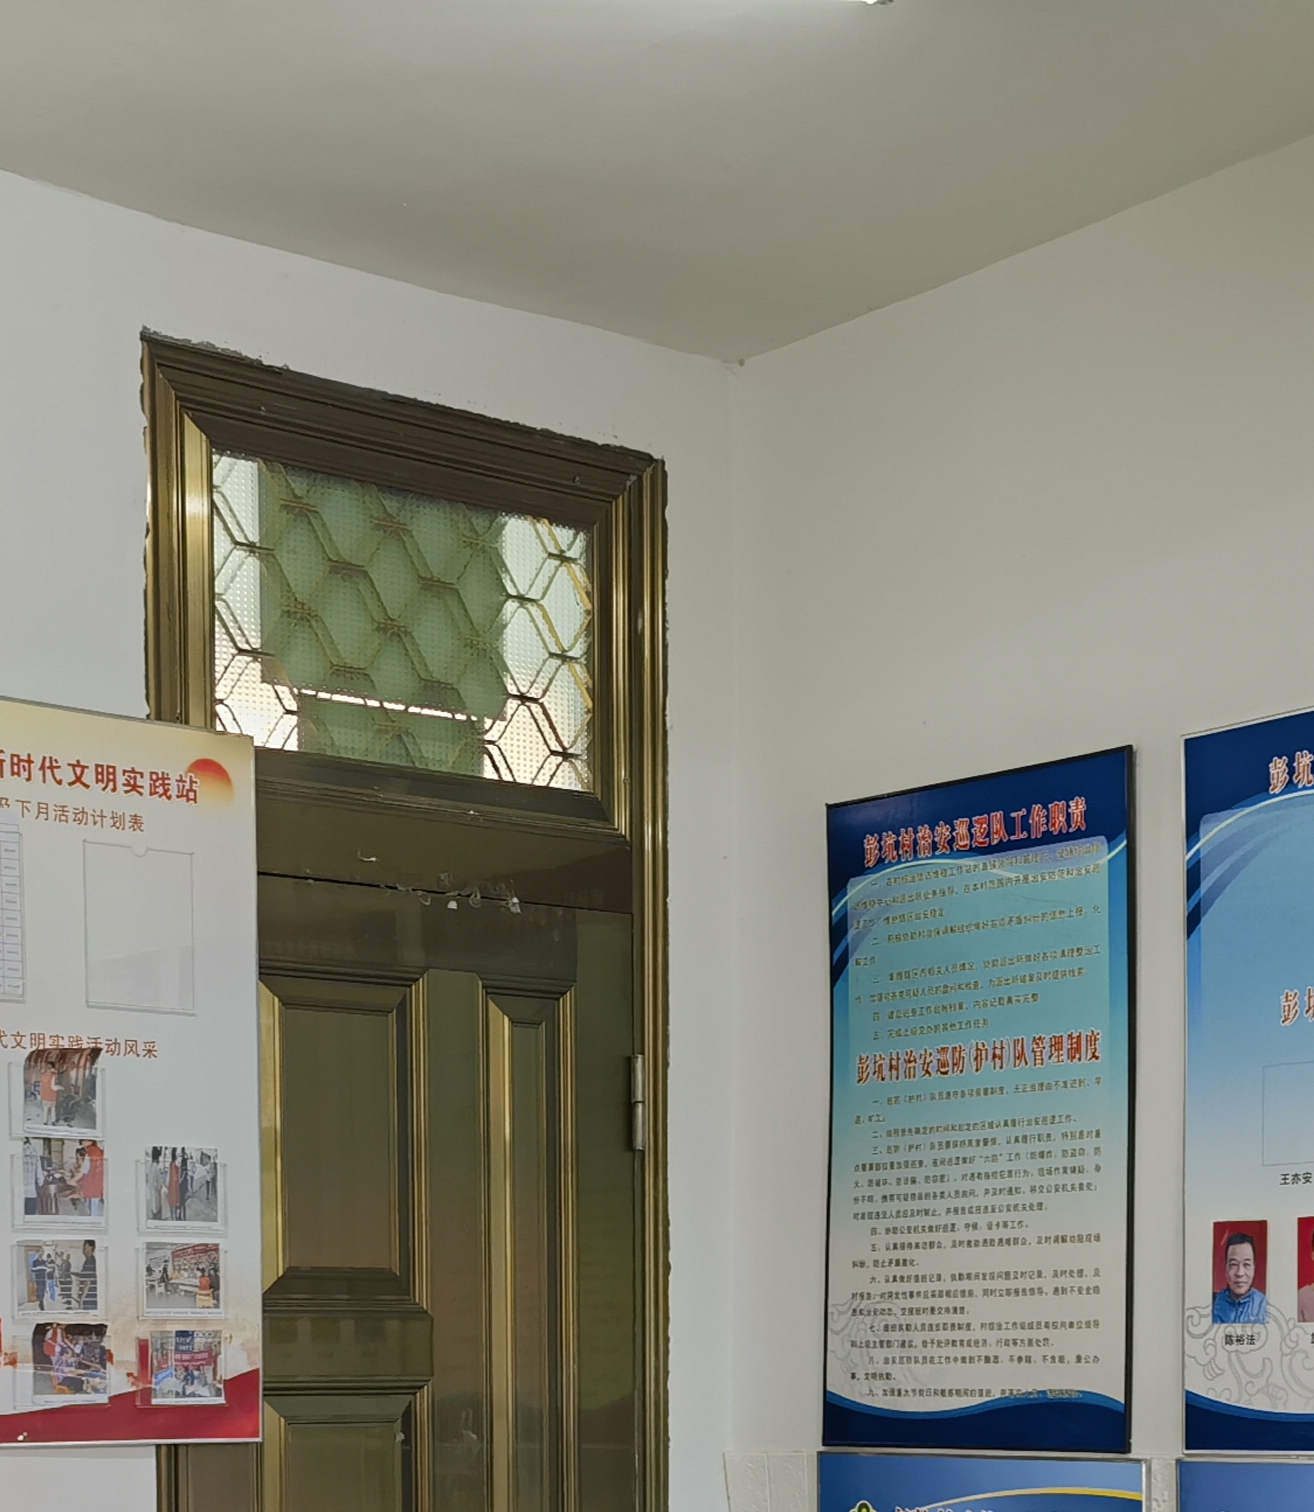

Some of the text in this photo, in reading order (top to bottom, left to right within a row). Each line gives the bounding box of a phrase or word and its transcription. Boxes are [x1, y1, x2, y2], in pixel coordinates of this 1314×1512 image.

[0, 749, 200, 804] 时代文明实践站
[863, 796, 1088, 868] 彭坑村治安巡逻队工作职责
[1279, 1171, 1313, 1186] 王亦安
